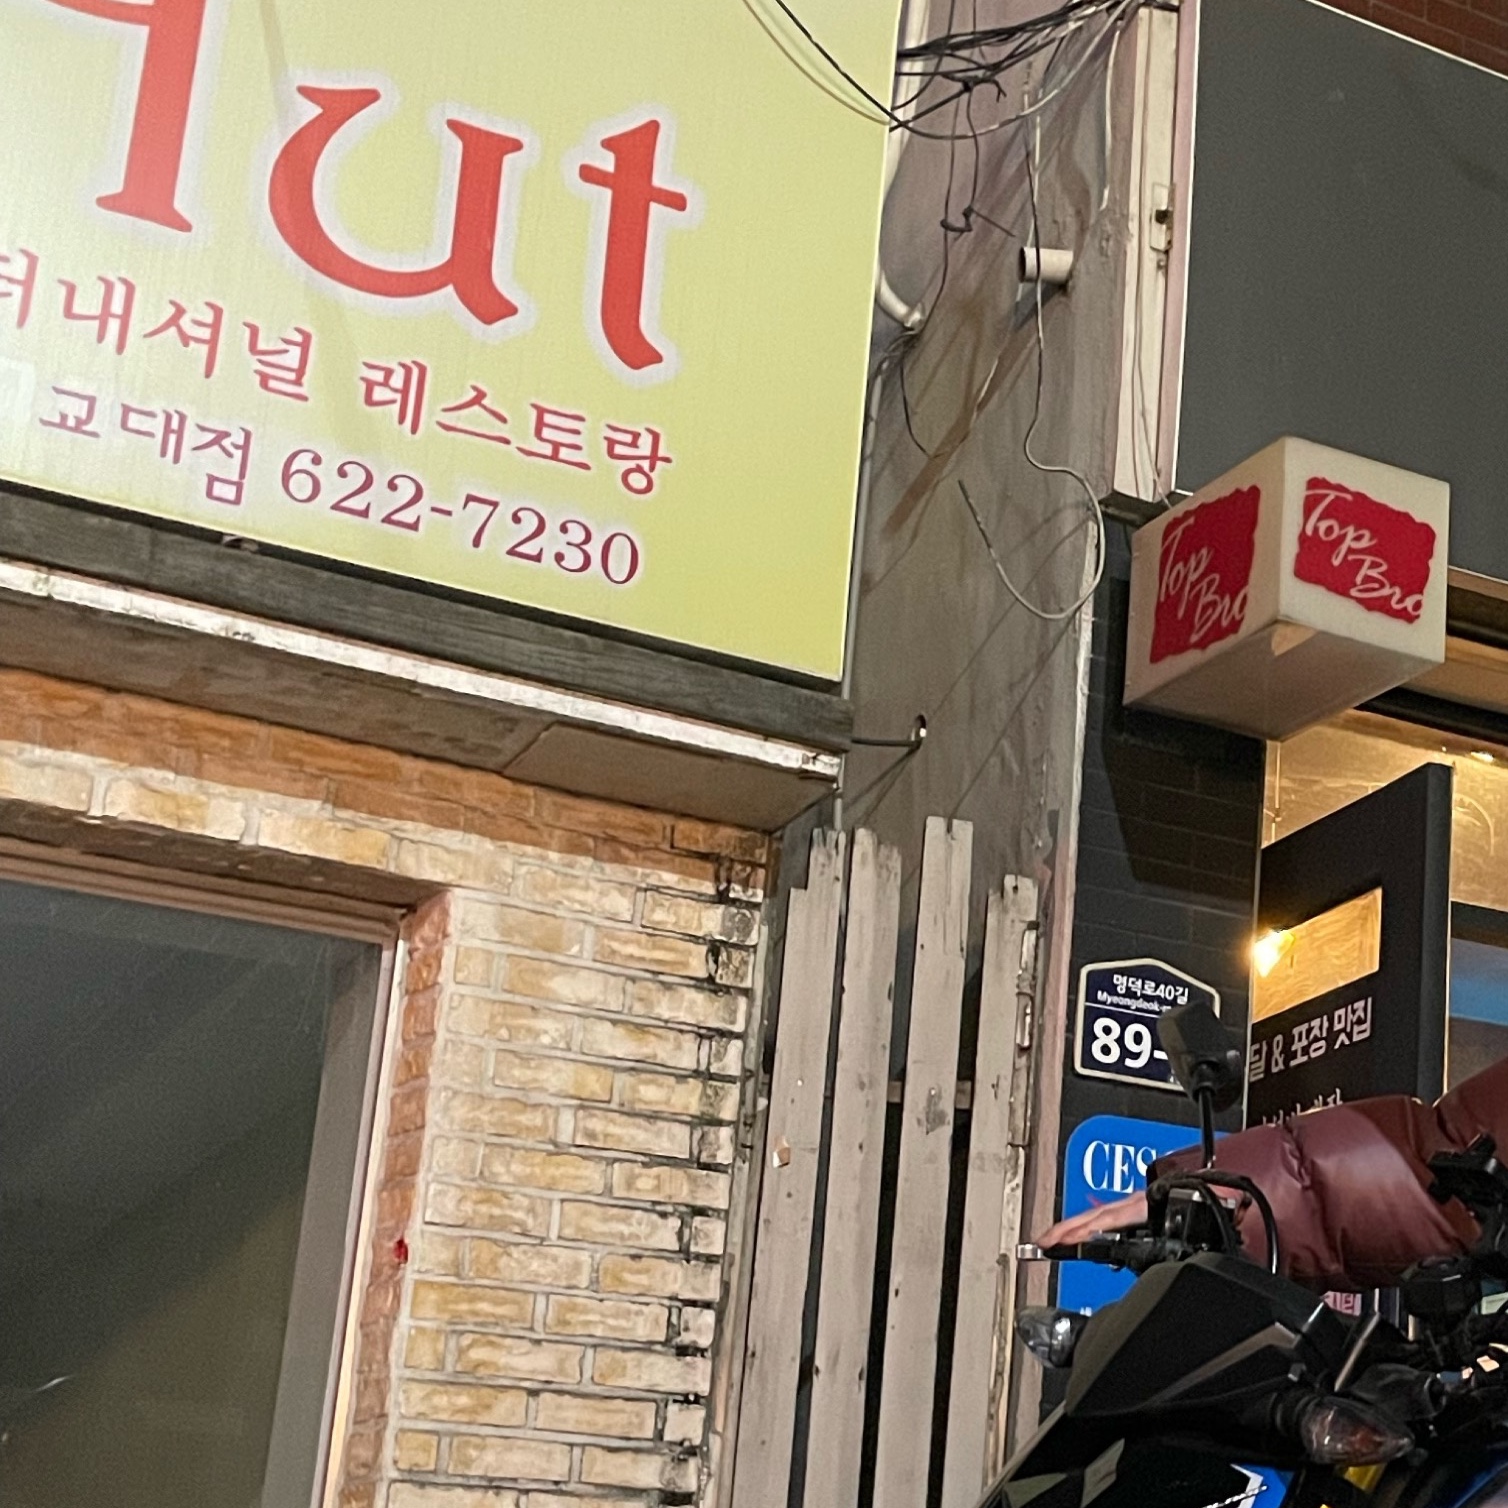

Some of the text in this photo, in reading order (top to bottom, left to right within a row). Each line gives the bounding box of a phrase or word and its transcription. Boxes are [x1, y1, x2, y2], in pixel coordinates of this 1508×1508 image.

[360, 360, 673, 496] 레스토랑
[39, 385, 640, 586] 교대점 622-7230
[1302, 488, 1377, 566] Top
[1160, 515, 1213, 621] Top
[1113, 973, 1189, 1005] 명덕로40길
[1271, 1034, 1285, 1073] &
[1289, 1014, 1328, 1067] 포장
[1333, 996, 1372, 1050] 맛집
